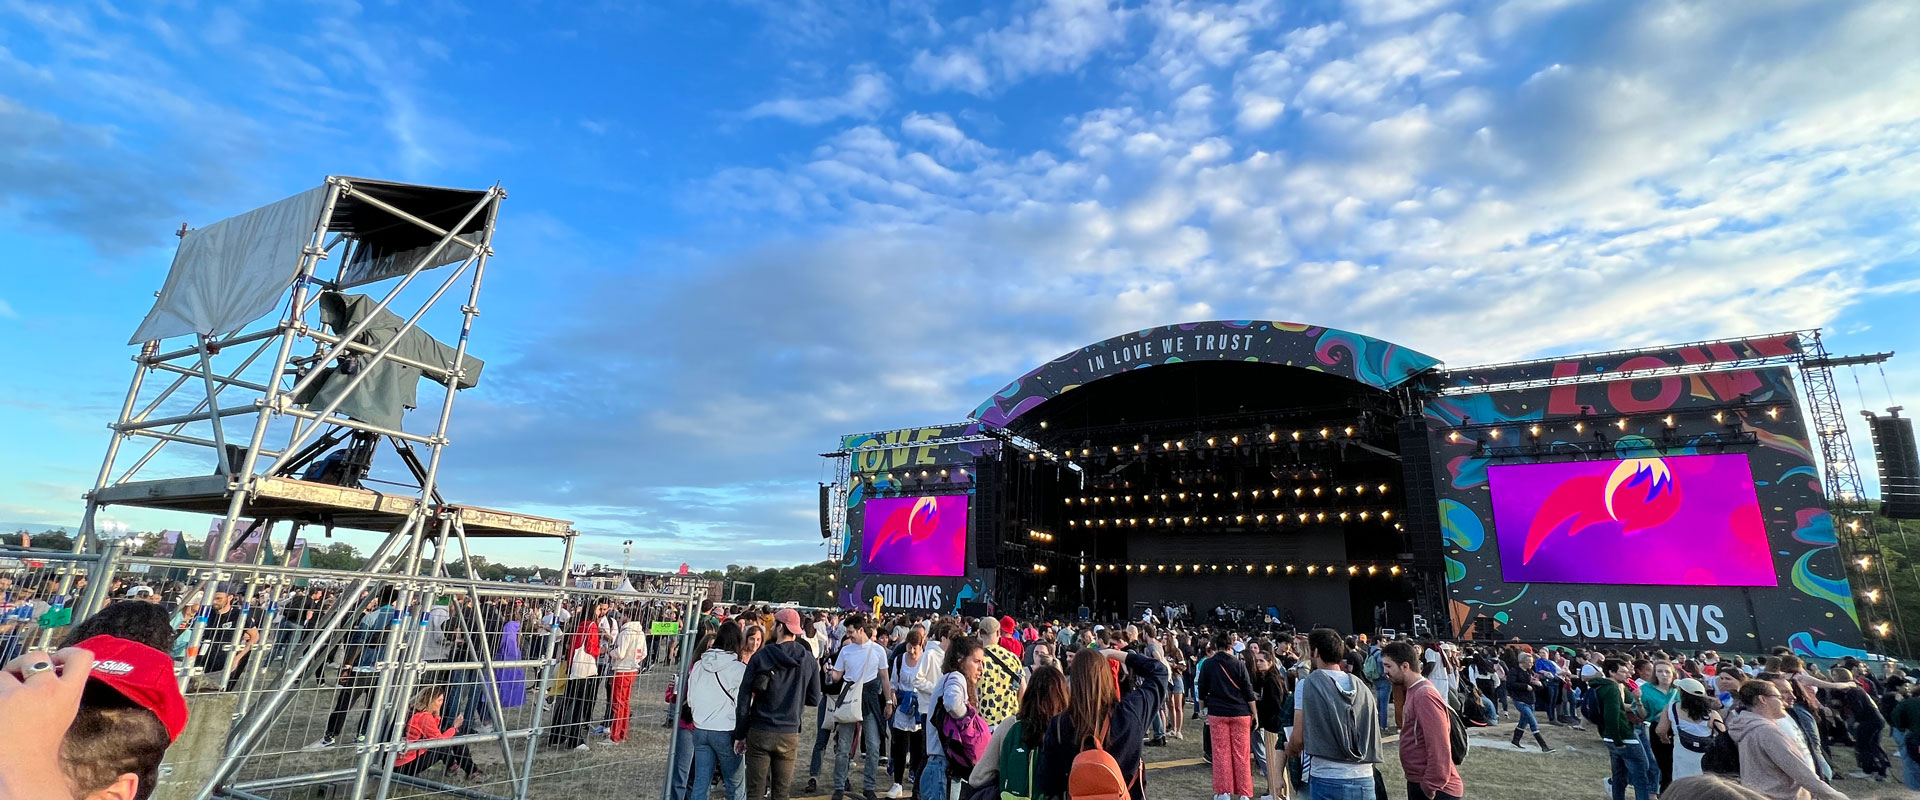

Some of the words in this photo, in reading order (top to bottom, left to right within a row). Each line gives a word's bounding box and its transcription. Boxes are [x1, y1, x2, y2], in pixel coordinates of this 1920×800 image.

[1087, 355, 1105, 373] IN
[1112, 342, 1152, 365] LOVE
[1161, 336, 1184, 353] WE
[1194, 334, 1254, 351] TRUST
[573, 563, 586, 574] WC
[876, 583, 942, 610] SOLIDAYS
[1556, 600, 1729, 645] SOLIDAYS
